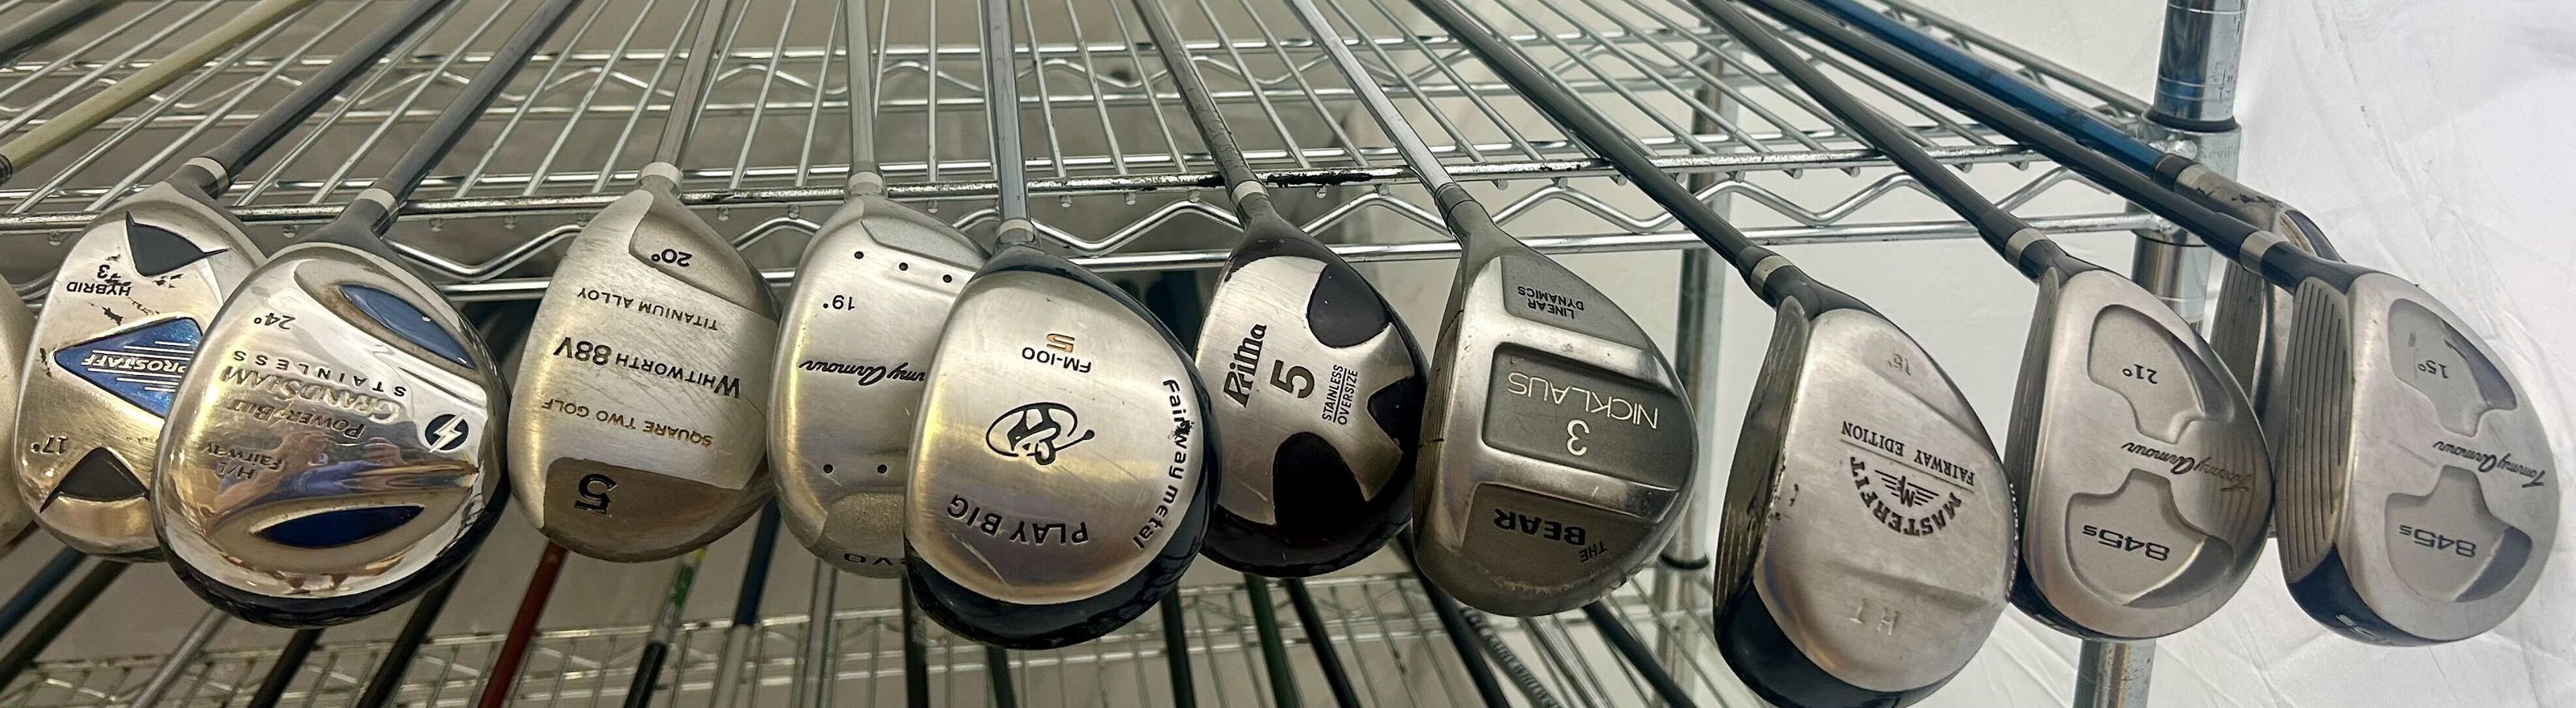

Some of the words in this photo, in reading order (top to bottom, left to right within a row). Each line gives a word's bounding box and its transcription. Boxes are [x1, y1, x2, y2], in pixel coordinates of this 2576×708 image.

[651, 249, 692, 267] 20°
[66, 282, 131, 296] HYBRID
[577, 287, 634, 308] ALLOY
[1517, 286, 1584, 311] DYNAMICS
[254, 313, 295, 330] 24°
[638, 303, 718, 331] TITANIUM
[1527, 298, 1575, 319] LINEAR
[553, 336, 612, 366] 88V
[1022, 347, 1092, 373] FM-100
[1223, 323, 1267, 408] Prima
[233, 351, 407, 397] STAINLESS
[615, 352, 740, 398] WHITWORTH
[1270, 359, 1315, 399] 5
[2123, 363, 2158, 385] 21°
[2417, 360, 2449, 379] 15°
[542, 398, 589, 418] GOLF
[1321, 364, 1344, 421] STAINLESS
[1337, 368, 1359, 426] OVERSIZE
[1507, 372, 1658, 429] NICKLAUS
[596, 410, 636, 430] TWO
[643, 421, 713, 447] SQUARE
[1567, 418, 1590, 456] 3
[1841, 421, 1905, 457] EDITION
[1913, 449, 1975, 486] FAIRWAY
[2120, 442, 2195, 475] Armour
[2194, 456, 2252, 492] Tommy
[2433, 441, 2496, 473] Armour
[2496, 453, 2545, 488] Tommy
[574, 473, 617, 515] 5
[1850, 456, 1962, 537] MASTERFIT
[947, 495, 1003, 537] BIG
[1009, 521, 1089, 545] PLAY
[1133, 484, 1179, 549] metal
[1493, 508, 1586, 546] BEAR
[1579, 541, 1608, 563] THE
[2083, 525, 2170, 562] 845s
[2399, 524, 2477, 558] 845s
